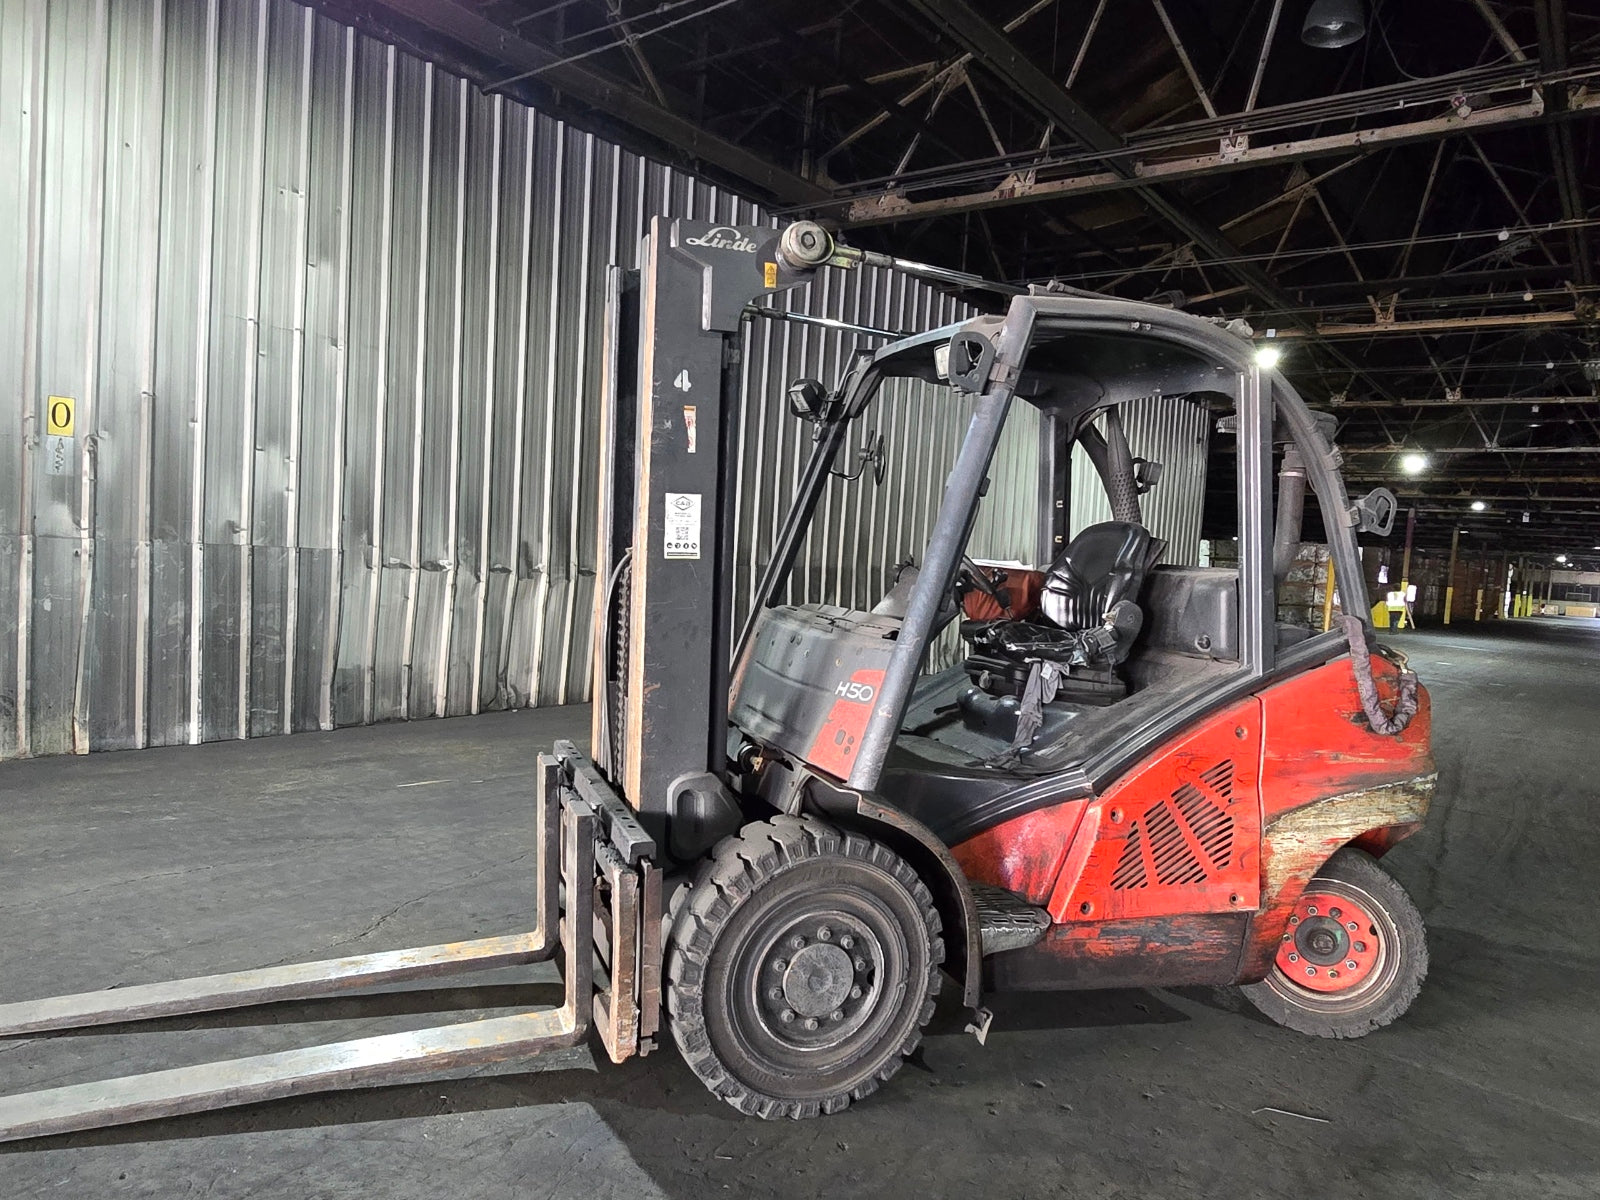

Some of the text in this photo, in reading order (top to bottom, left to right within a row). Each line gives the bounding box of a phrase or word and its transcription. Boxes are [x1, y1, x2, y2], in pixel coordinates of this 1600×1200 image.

[686, 226, 758, 254] Linde
[673, 369, 692, 393] 4
[835, 681, 874, 702] H50
